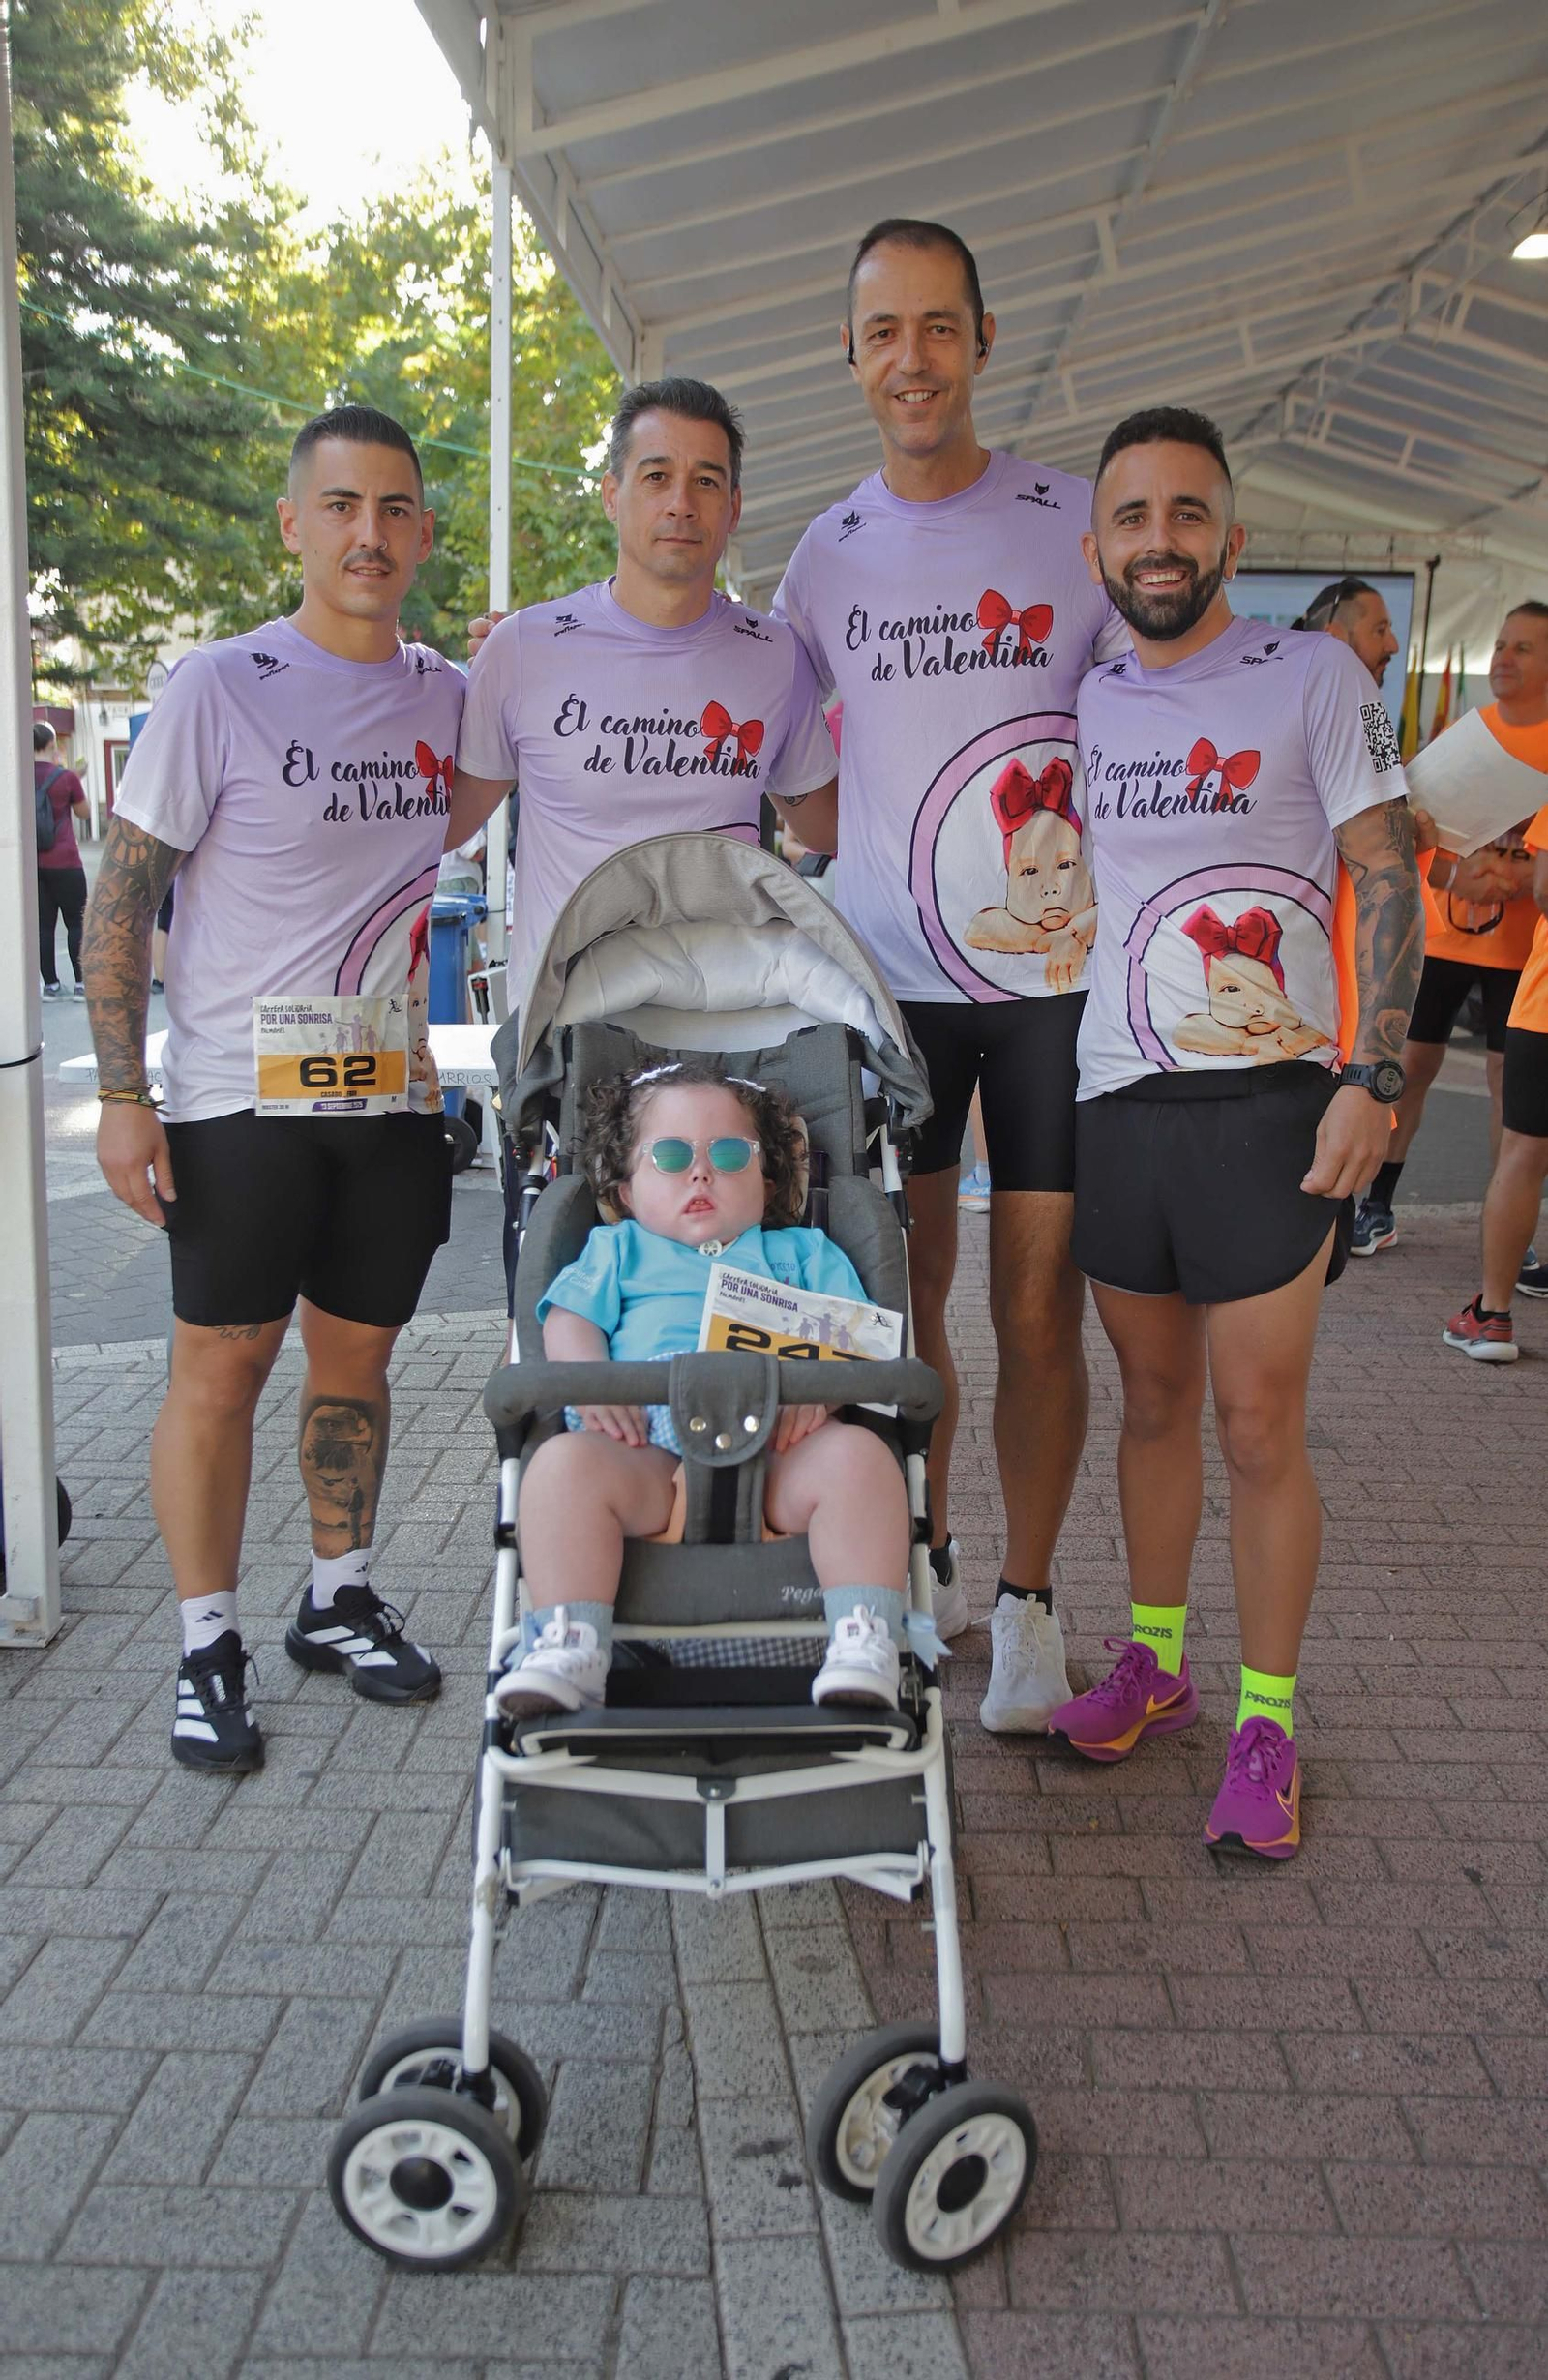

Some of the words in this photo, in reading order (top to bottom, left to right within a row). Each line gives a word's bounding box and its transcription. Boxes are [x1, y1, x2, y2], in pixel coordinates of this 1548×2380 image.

[846, 604, 872, 651] El
[878, 605, 980, 640] camino
[871, 653, 897, 681] de
[903, 633, 1054, 679] Valentina
[553, 693, 591, 737] El
[600, 708, 703, 737] camino
[282, 740, 320, 787] El
[331, 751, 419, 782] camino
[583, 744, 616, 773] de
[624, 735, 761, 779] Valentina
[1087, 744, 1103, 788] El
[1105, 751, 1189, 782] camino
[323, 792, 353, 822] de
[1094, 791, 1112, 819] de
[1116, 777, 1258, 818] Valentina
[260, 1014, 278, 1025] POR
[279, 1014, 296, 1025] UNA
[297, 1014, 333, 1025] SONRISA
[300, 1056, 376, 1087] 62
[721, 1279, 738, 1294] POR
[740, 1287, 759, 1301] UNA
[759, 1293, 798, 1313] SONRISA
